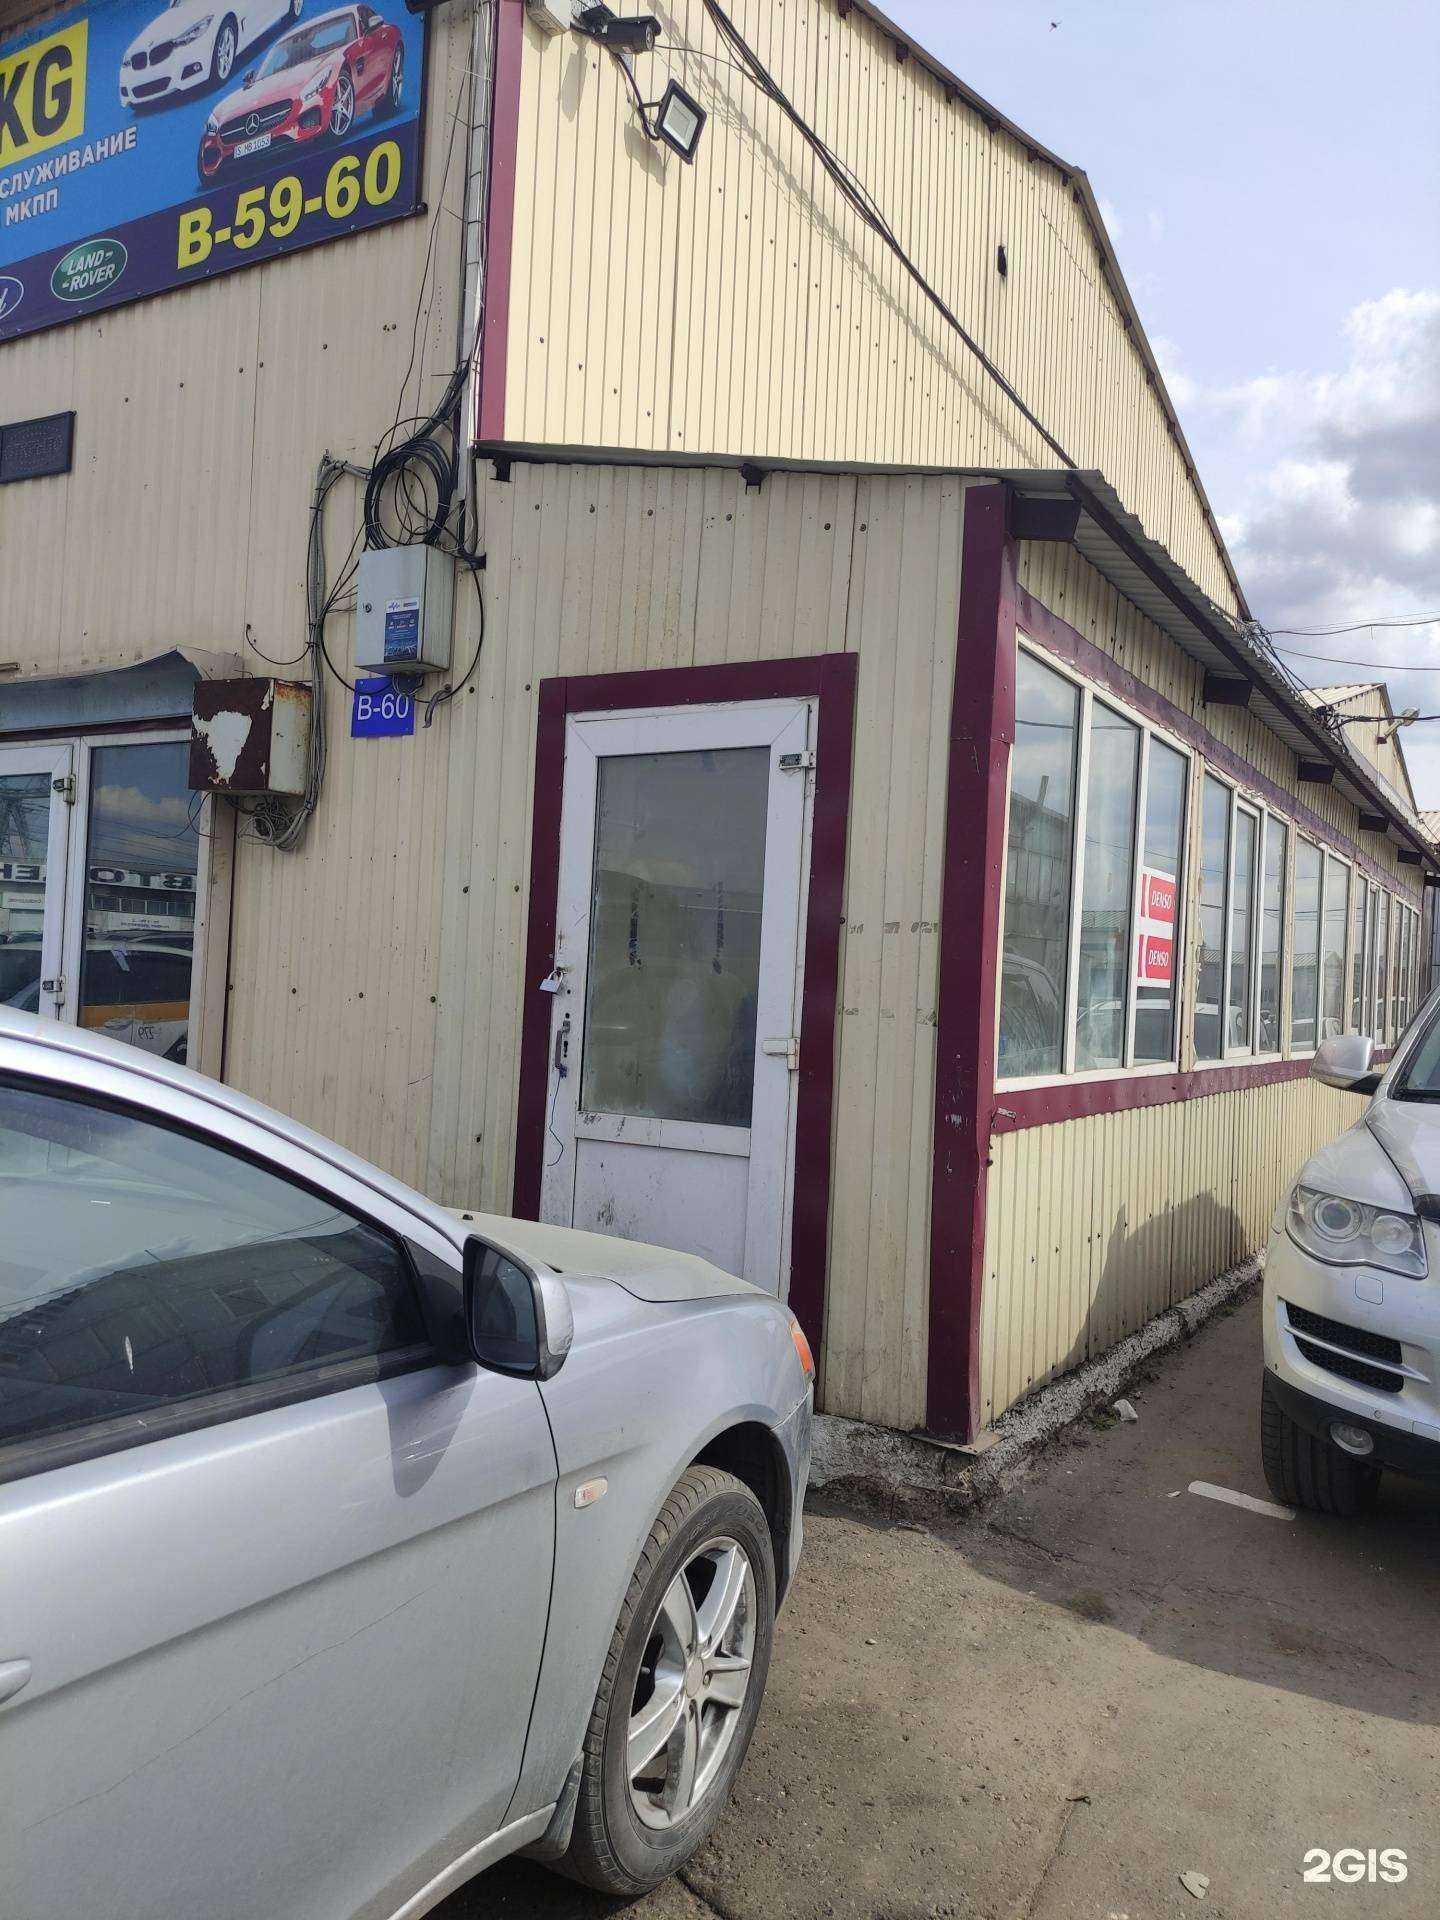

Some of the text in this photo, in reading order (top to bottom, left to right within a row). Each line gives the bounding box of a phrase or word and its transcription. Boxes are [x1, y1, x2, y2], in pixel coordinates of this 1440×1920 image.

[0, 127, 137, 198] СЛУЖИВАНИЕ
[6, 188, 58, 226] МКПП
[177, 140, 401, 269] В-59-60
[357, 693, 409, 720] В-60
[1151, 889, 1172, 910] DENSO
[1148, 949, 1169, 967] DENSO
